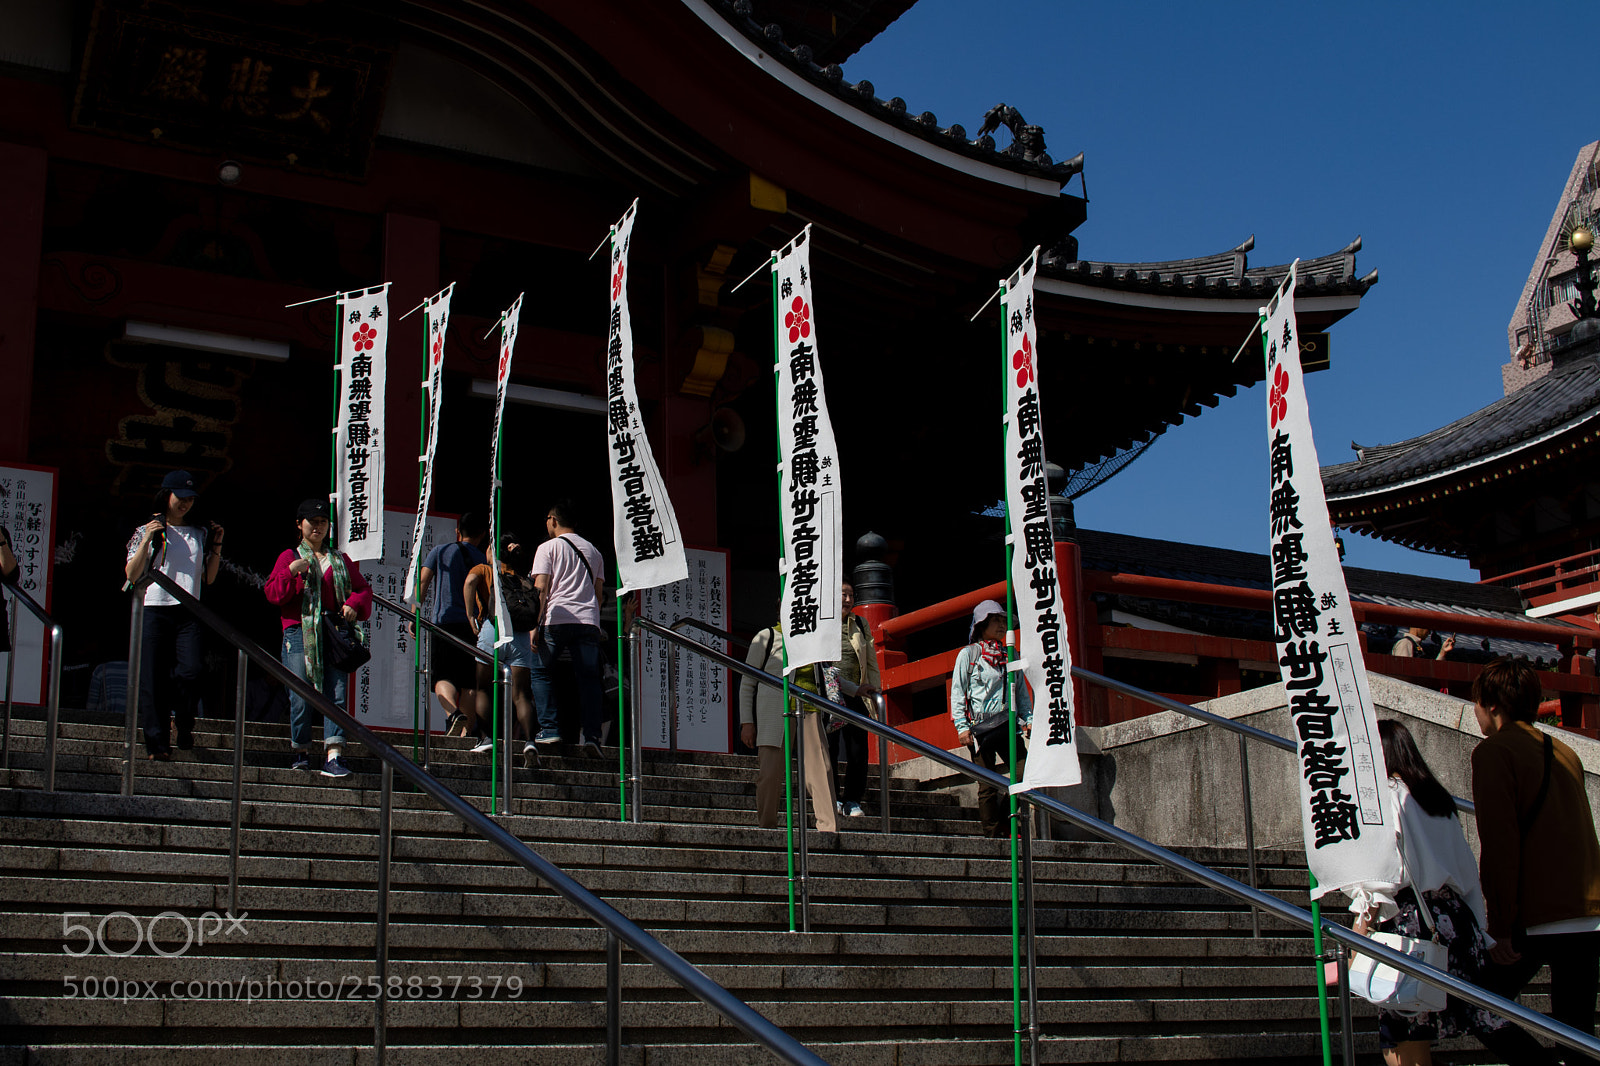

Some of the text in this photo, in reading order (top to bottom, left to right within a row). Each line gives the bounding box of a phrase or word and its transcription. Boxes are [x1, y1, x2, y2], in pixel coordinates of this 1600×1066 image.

[23, 502, 42, 591] 写経のすすめ
